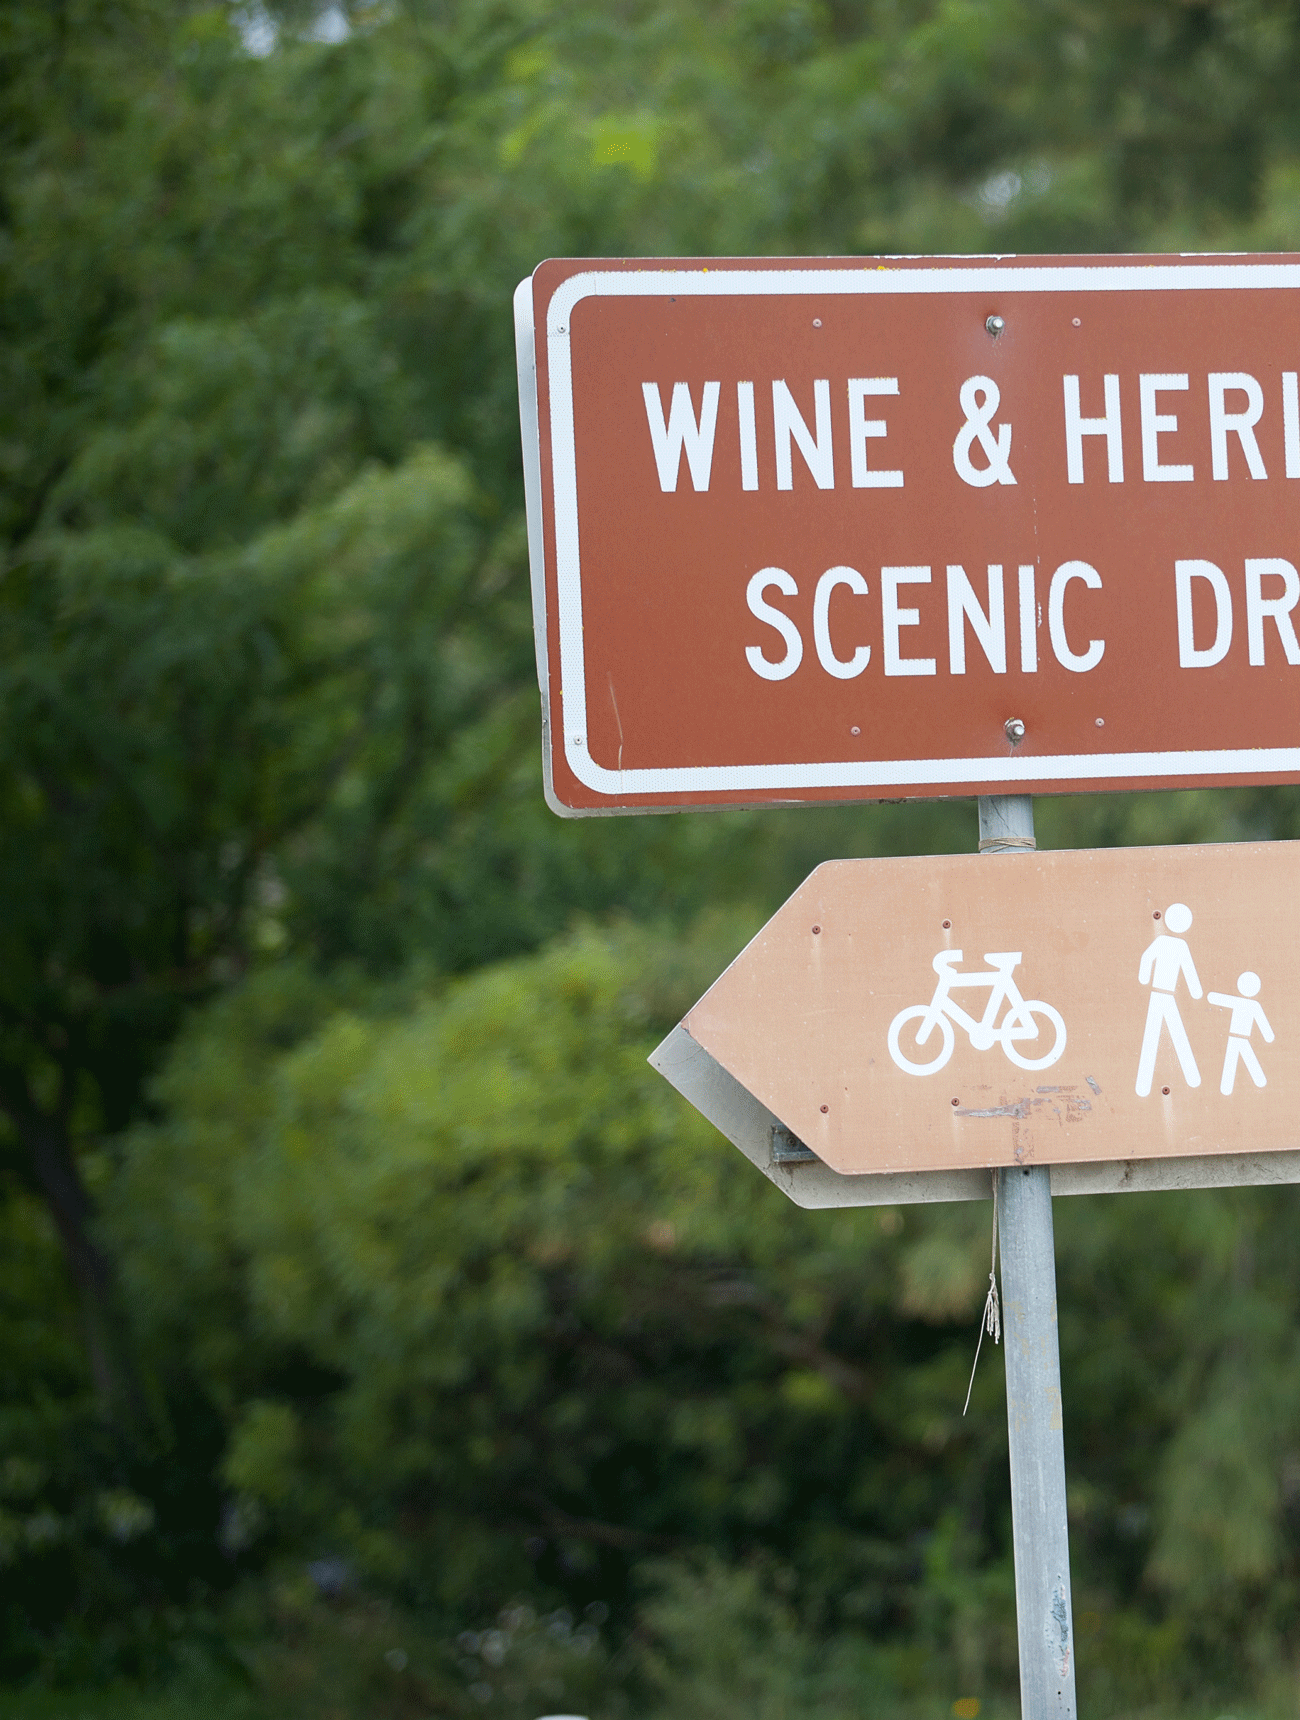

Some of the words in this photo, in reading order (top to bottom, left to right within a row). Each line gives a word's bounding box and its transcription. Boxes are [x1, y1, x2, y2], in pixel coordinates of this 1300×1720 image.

[641, 376, 905, 493] WINE
[952, 374, 1019, 488] &
[744, 559, 1106, 681] SCENIC
